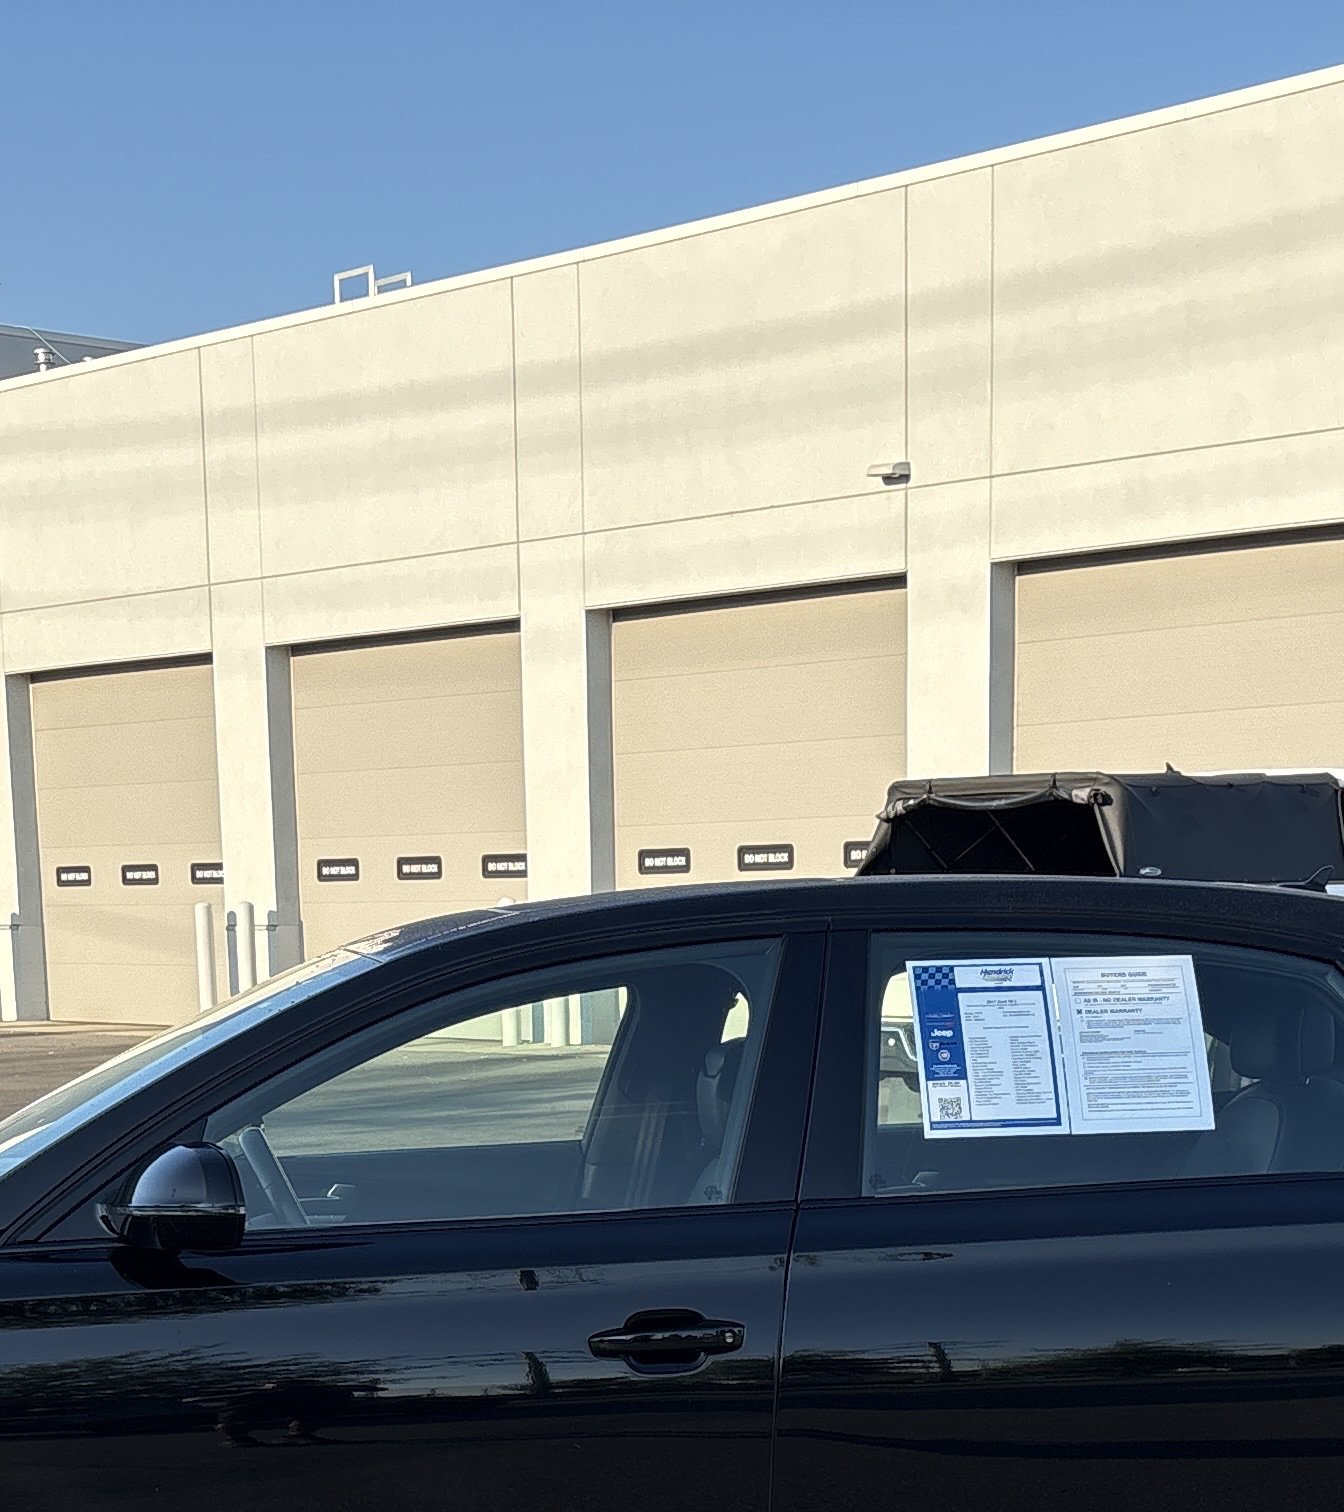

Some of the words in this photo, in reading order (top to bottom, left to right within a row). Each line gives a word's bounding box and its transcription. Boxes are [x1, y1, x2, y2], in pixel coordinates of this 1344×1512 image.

[644, 857, 654, 867] DO
[654, 857, 666, 866] NOT
[667, 856, 687, 865] BLOCK
[744, 853, 754, 863] DO
[755, 853, 767, 863] NOT
[768, 852, 789, 862] BLOCK
[402, 864, 410, 873] DO
[980, 967, 1015, 978] Hendrick
[930, 1028, 954, 1038] Jeep
